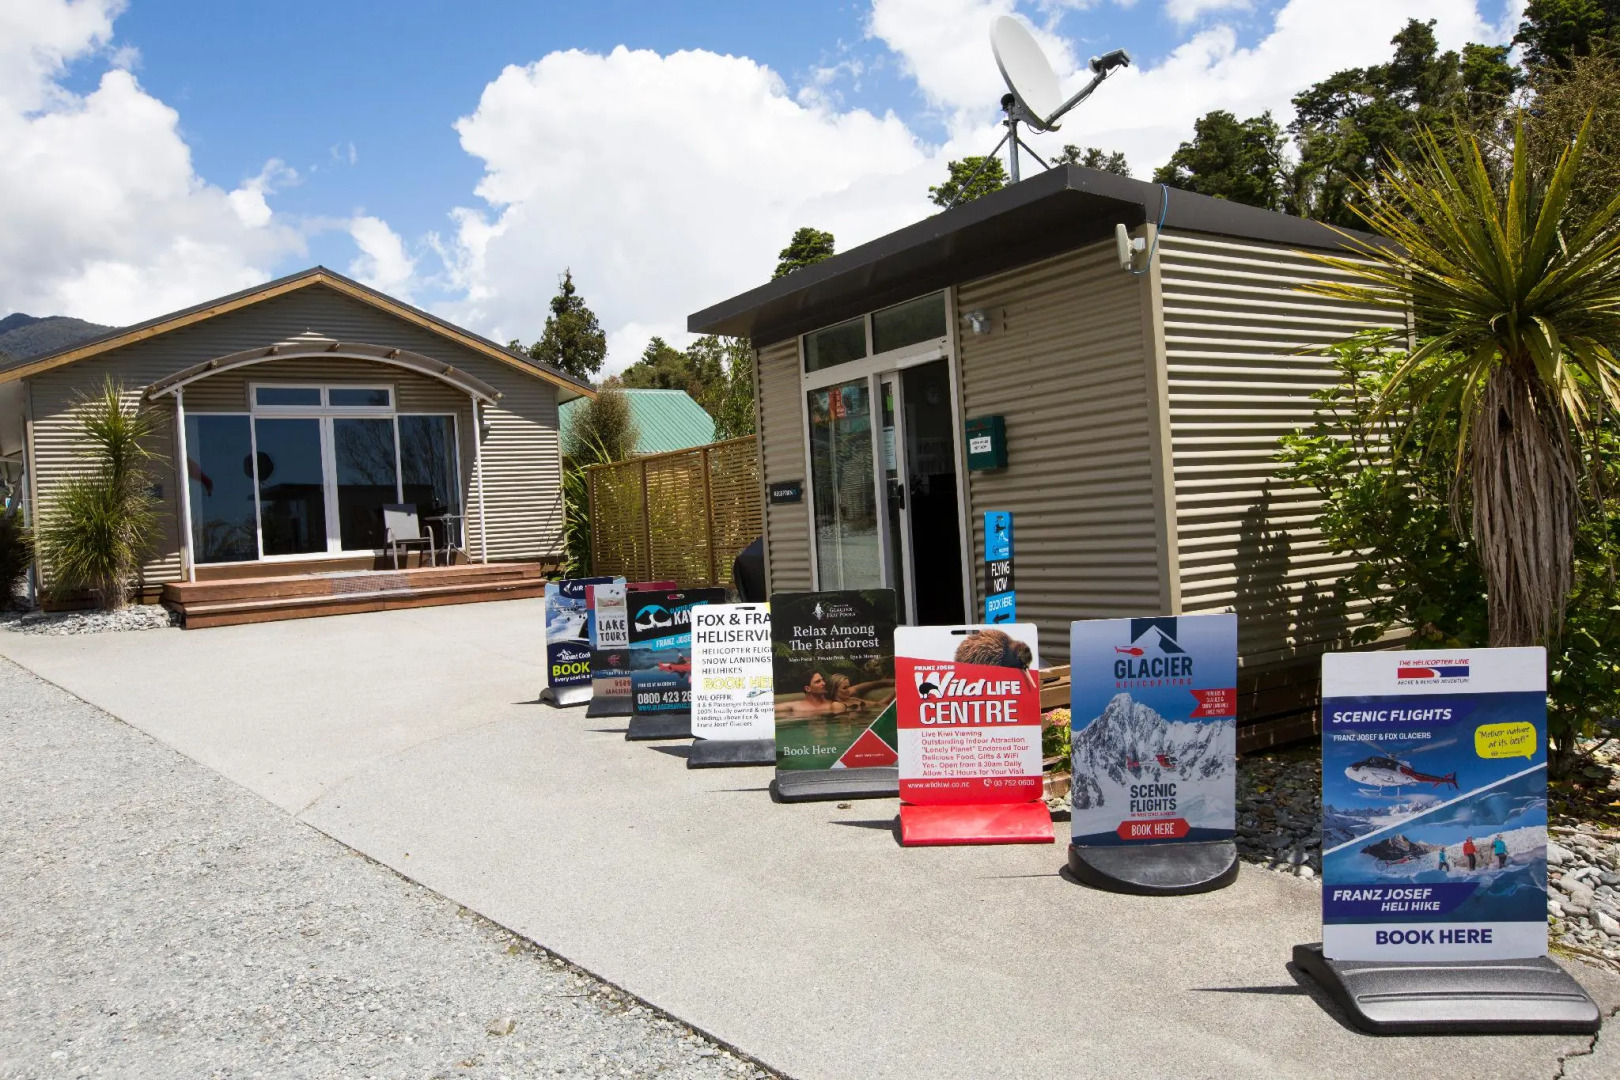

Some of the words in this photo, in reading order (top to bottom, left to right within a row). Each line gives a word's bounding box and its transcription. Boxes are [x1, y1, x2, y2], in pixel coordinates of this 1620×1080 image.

[991, 561, 1010, 576] FLYING
[993, 577, 1008, 592] NOW
[988, 599, 1002, 612] BOOK
[1002, 596, 1013, 608] HERE
[697, 614, 725, 626] FOX
[729, 613, 741, 626] &
[745, 612, 772, 625] FRA
[599, 620, 626, 632] LAKE
[793, 626, 827, 637] Relax
[830, 625, 875, 636] Among
[600, 631, 627, 642] TOURS
[656, 637, 675, 648] FRANZ
[697, 629, 772, 643] HELISERVI
[789, 639, 812, 651] The
[816, 637, 880, 650] Rainforest
[702, 647, 751, 655] HELICOPTER
[730, 656, 772, 664] LANDINGS
[552, 661, 590, 677] BOOK
[702, 667, 743, 675] HELIHIKES
[1114, 656, 1193, 680] GLACIER
[704, 677, 746, 690] BOOK
[1115, 678, 1192, 689] HELICOPTERS
[637, 692, 661, 704] 0800
[662, 690, 680, 703] 423
[920, 700, 1018, 725] CENTRE
[1333, 710, 1388, 723] SCENIC
[1390, 708, 1452, 722] FLIGHTS
[921, 730, 936, 738] Live
[955, 730, 983, 738] Viewing
[1333, 734, 1356, 742] FRANZ
[1356, 733, 1378, 741] JOSEF
[1385, 732, 1398, 740] FOX
[1399, 732, 1432, 740] GLACIERS
[1506, 726, 1531, 735] nature
[783, 746, 810, 756] Book
[812, 745, 837, 755] Here
[1488, 740, 1497, 748] at
[939, 761, 959, 769] Open
[960, 760, 976, 768] from
[1004, 759, 1023, 767] Daily
[907, 781, 971, 789] www.wildkiwi.co.nz
[1004, 779, 1017, 787] 752
[1130, 783, 1177, 798] SCENIC
[1130, 798, 1177, 812] FLIGHTS
[1131, 824, 1152, 836] BOOK
[1154, 822, 1175, 835] HERE
[1333, 889, 1381, 901] FRANZ
[1384, 888, 1433, 900] JOSEF
[1381, 902, 1408, 912] HELI
[1410, 902, 1441, 911] HIKE
[1375, 930, 1434, 945] BOOK
[1439, 929, 1493, 944] HERE
